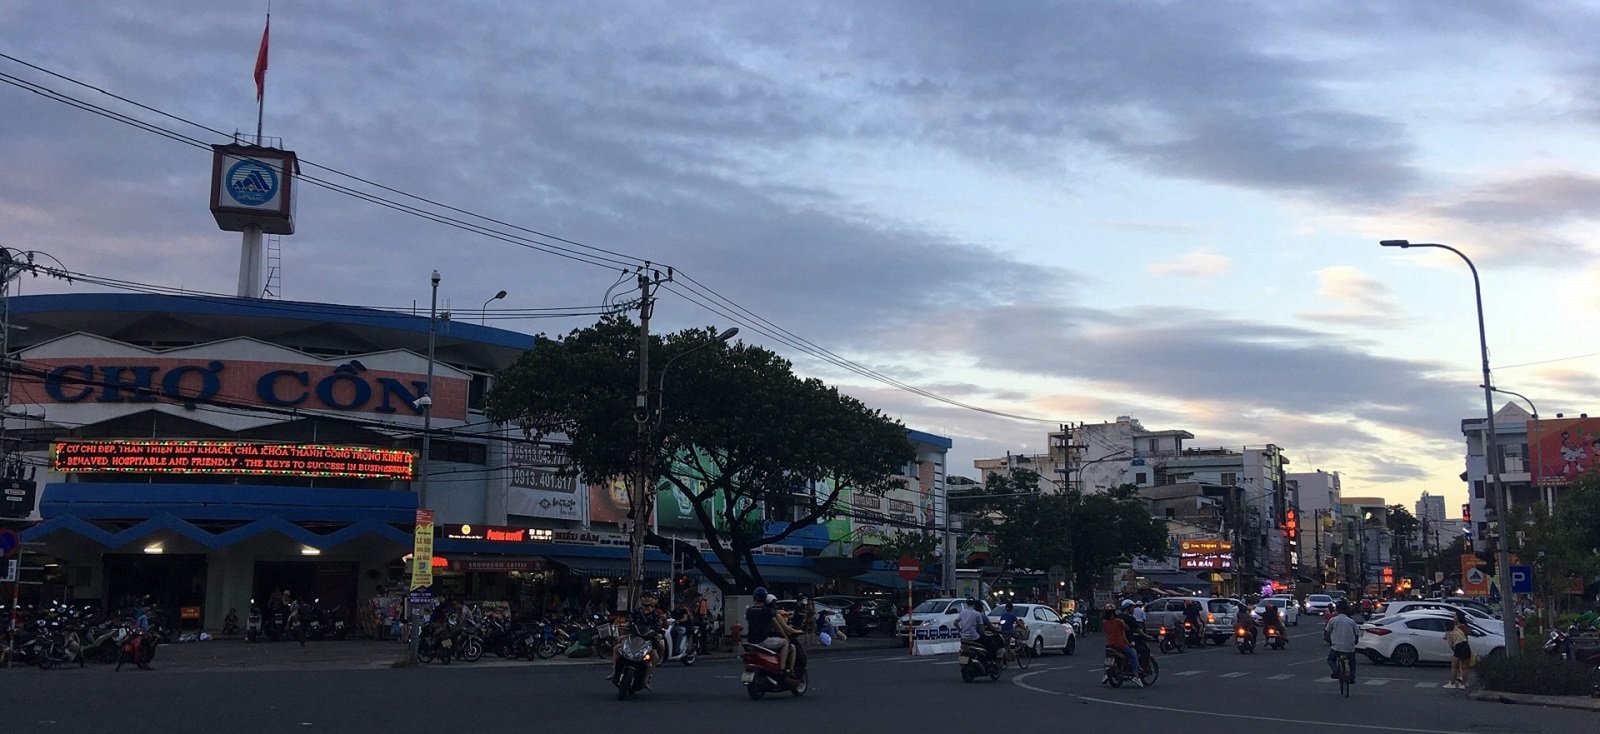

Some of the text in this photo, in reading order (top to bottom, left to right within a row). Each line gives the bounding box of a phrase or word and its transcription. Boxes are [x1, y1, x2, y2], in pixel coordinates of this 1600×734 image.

[45, 359, 429, 415] CHỢ CỒN
[112, 456, 167, 465] HOSPITABLE
[168, 457, 189, 466] AND
[191, 457, 238, 467] FRIENDLY
[244, 458, 264, 467] THE
[265, 459, 291, 468] KEYS
[291, 460, 305, 469] TO
[306, 460, 346, 470] SUCCESS
[347, 462, 357, 471] IN
[382, 453, 403, 462] KINH
[1511, 571, 1526, 587] P
